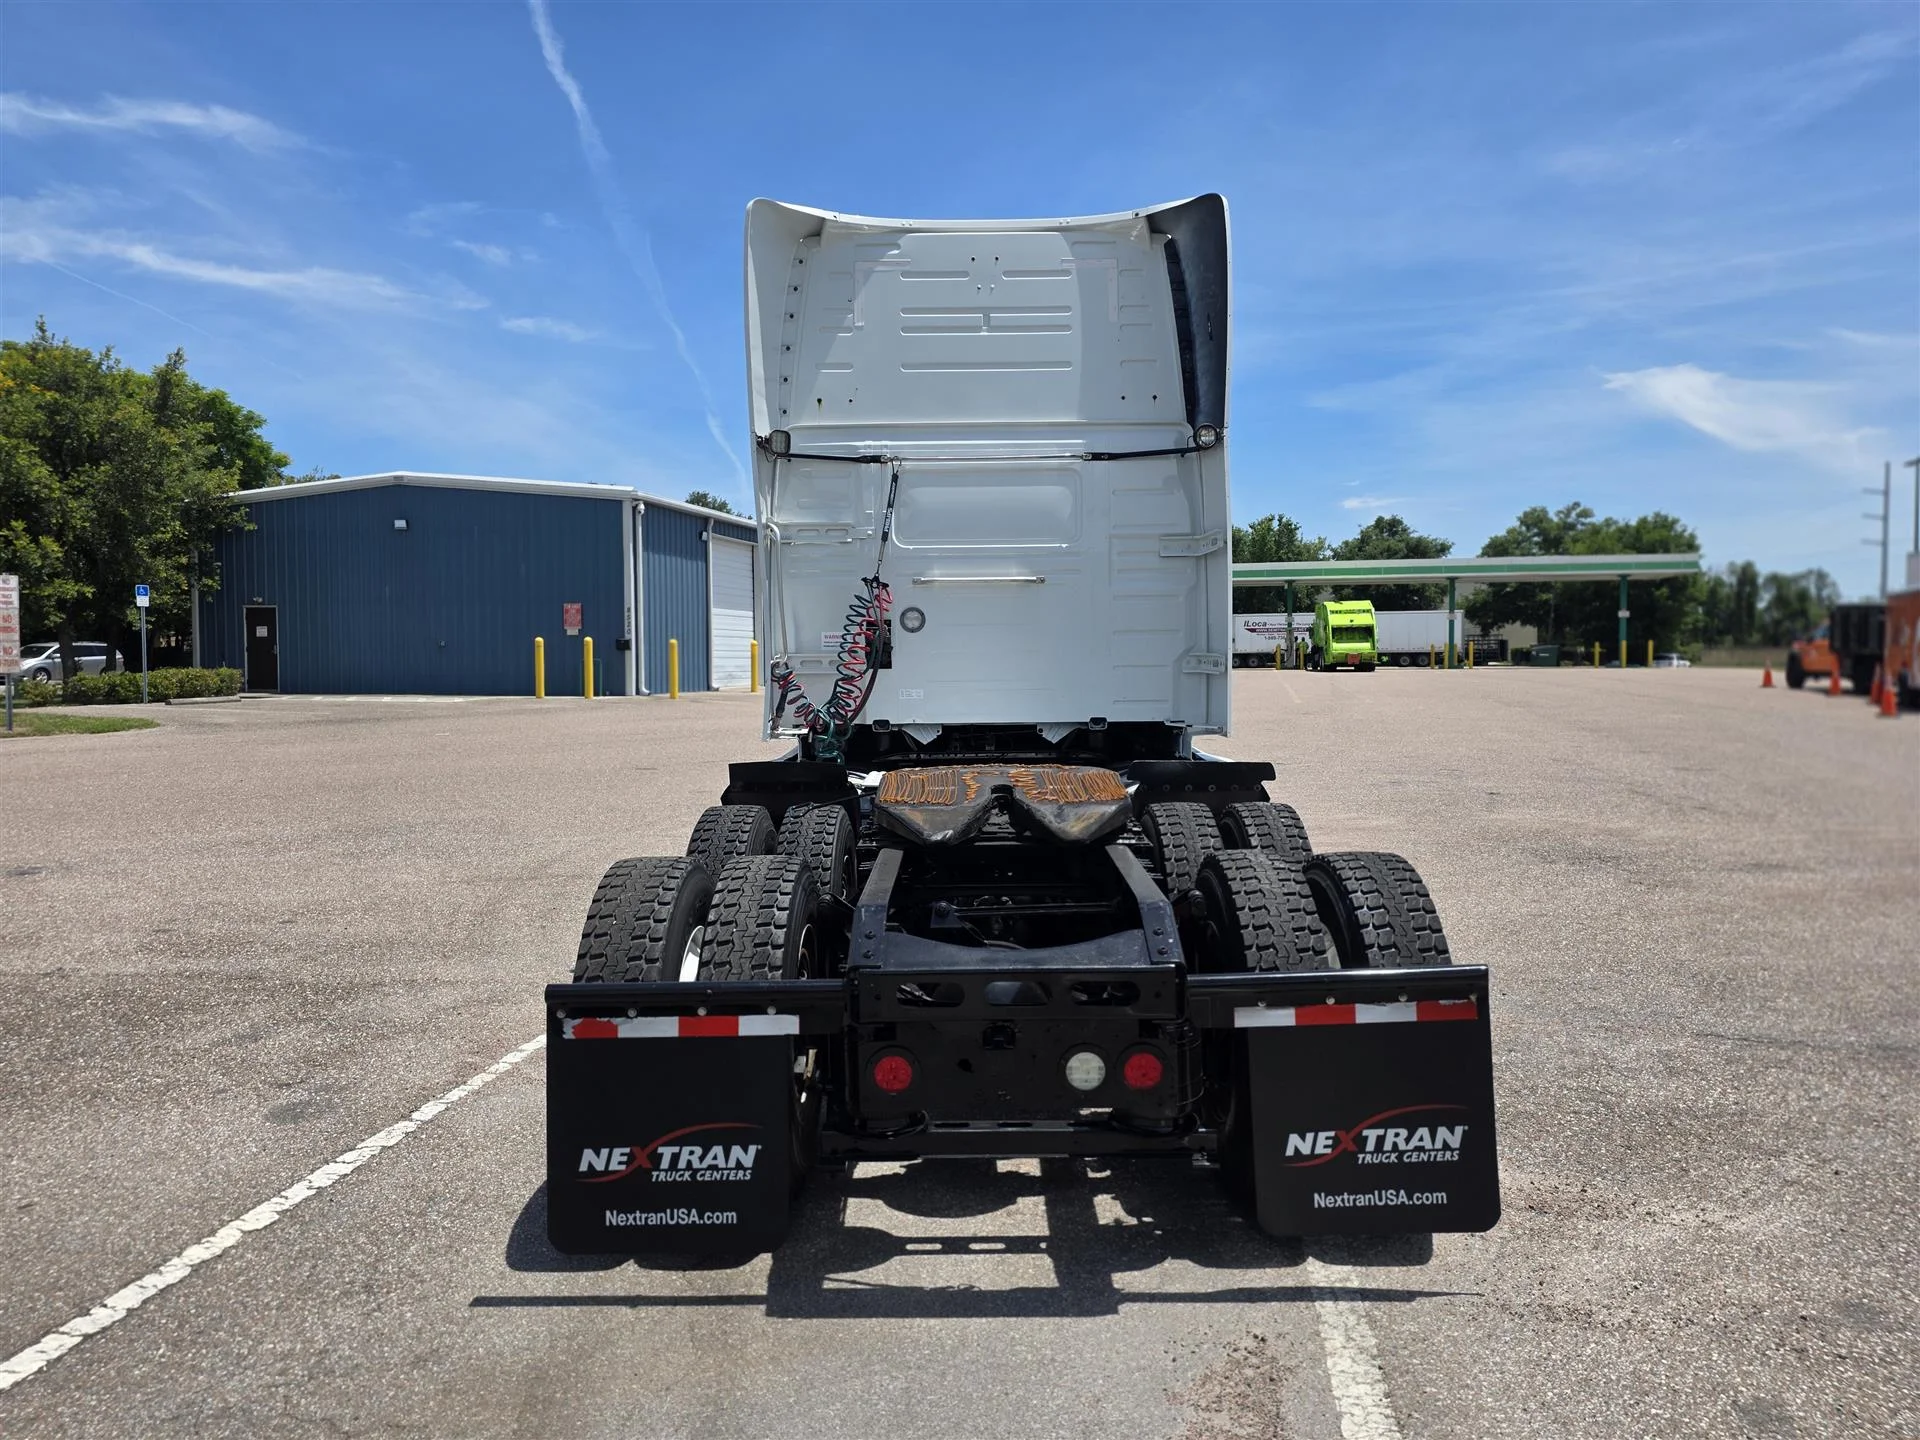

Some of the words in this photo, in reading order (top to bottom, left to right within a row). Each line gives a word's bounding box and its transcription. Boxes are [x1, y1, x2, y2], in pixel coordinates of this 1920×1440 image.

[1285, 1125, 1468, 1157] NEXTRAN
[578, 1144, 762, 1172] NEXTRAN
[1357, 1153, 1398, 1164] TRUCK
[1403, 1150, 1459, 1163] CENTERS
[652, 1171, 692, 1182] TRUCK
[696, 1170, 752, 1181] CENTERS
[1313, 1189, 1447, 1208] NextranUSA.com
[605, 1208, 737, 1226] NextranUSA.com
